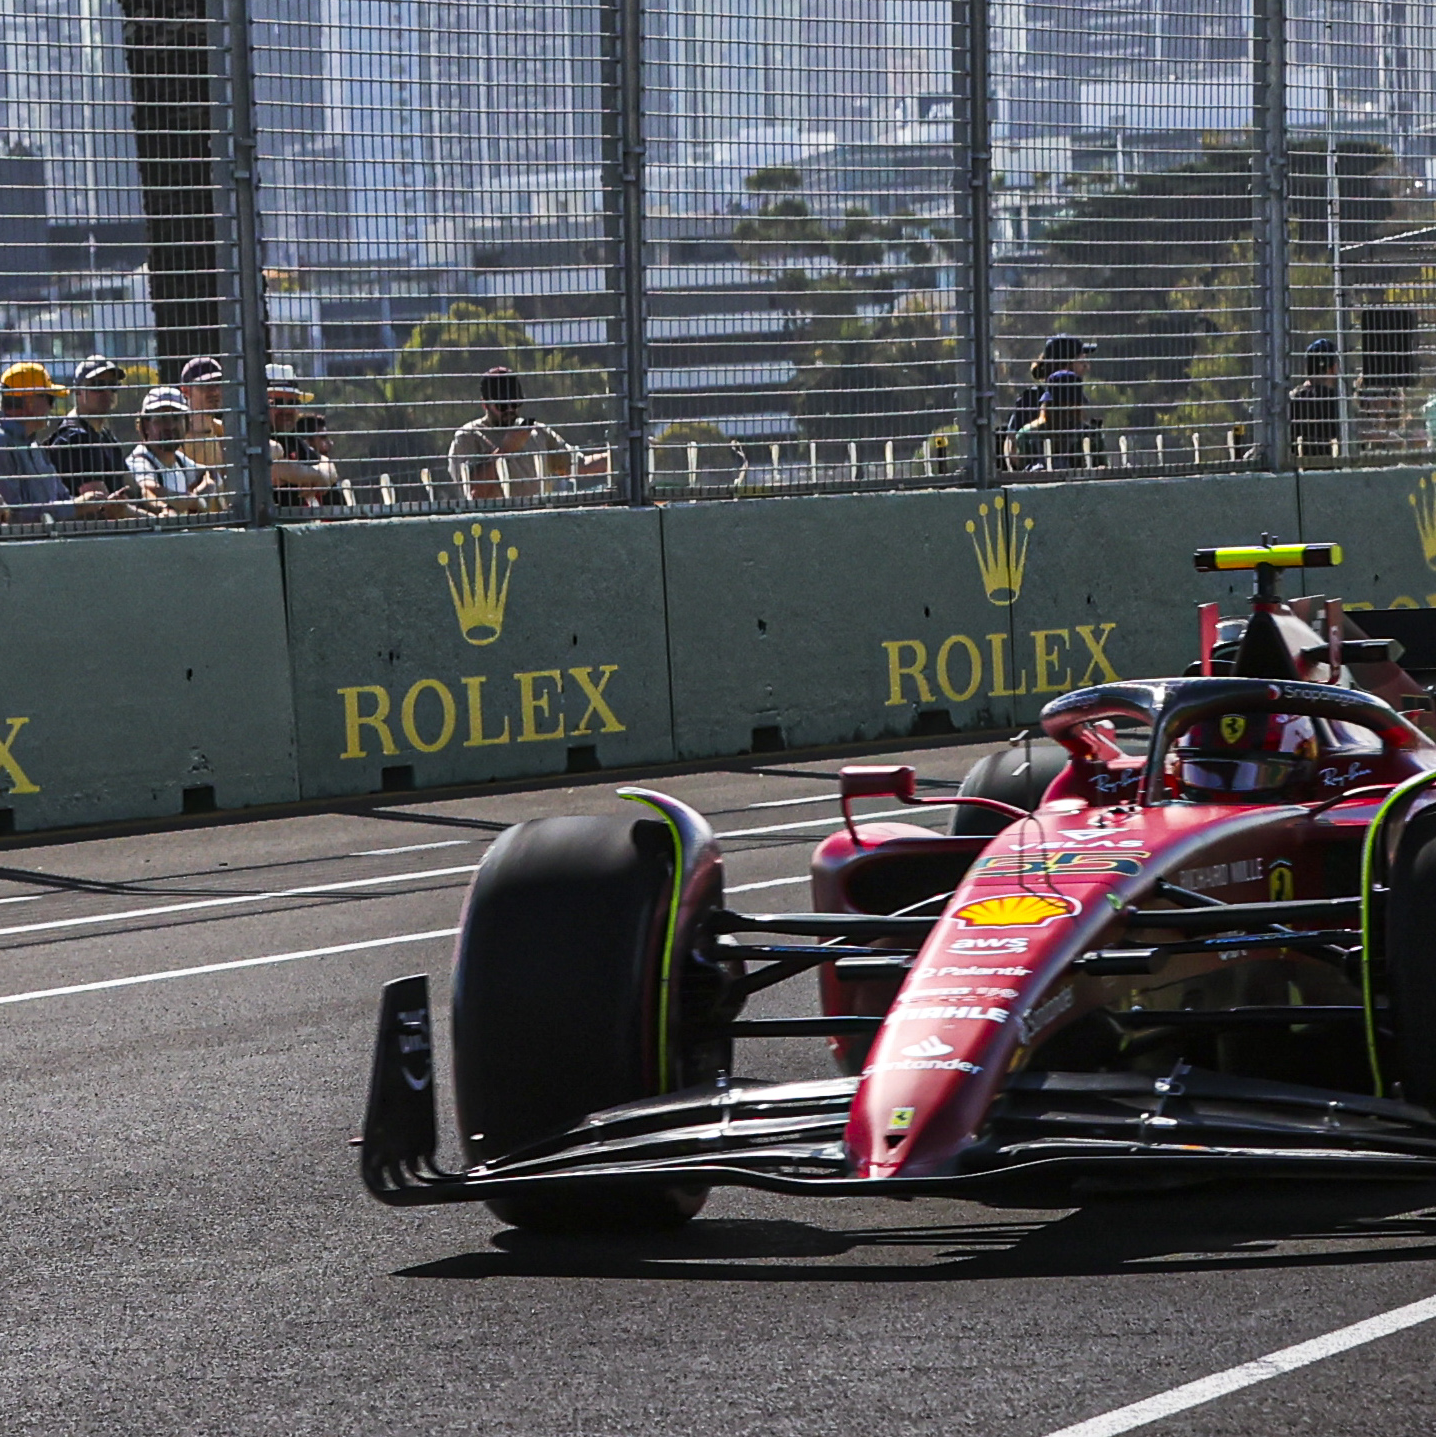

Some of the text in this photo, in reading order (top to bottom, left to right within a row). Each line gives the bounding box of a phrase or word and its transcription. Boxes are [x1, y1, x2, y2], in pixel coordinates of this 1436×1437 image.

[881, 622, 1123, 707] ROLEX
[337, 664, 627, 760] ROLEX
[950, 937, 1029, 949] aws
[938, 966, 1033, 977] Palantir
